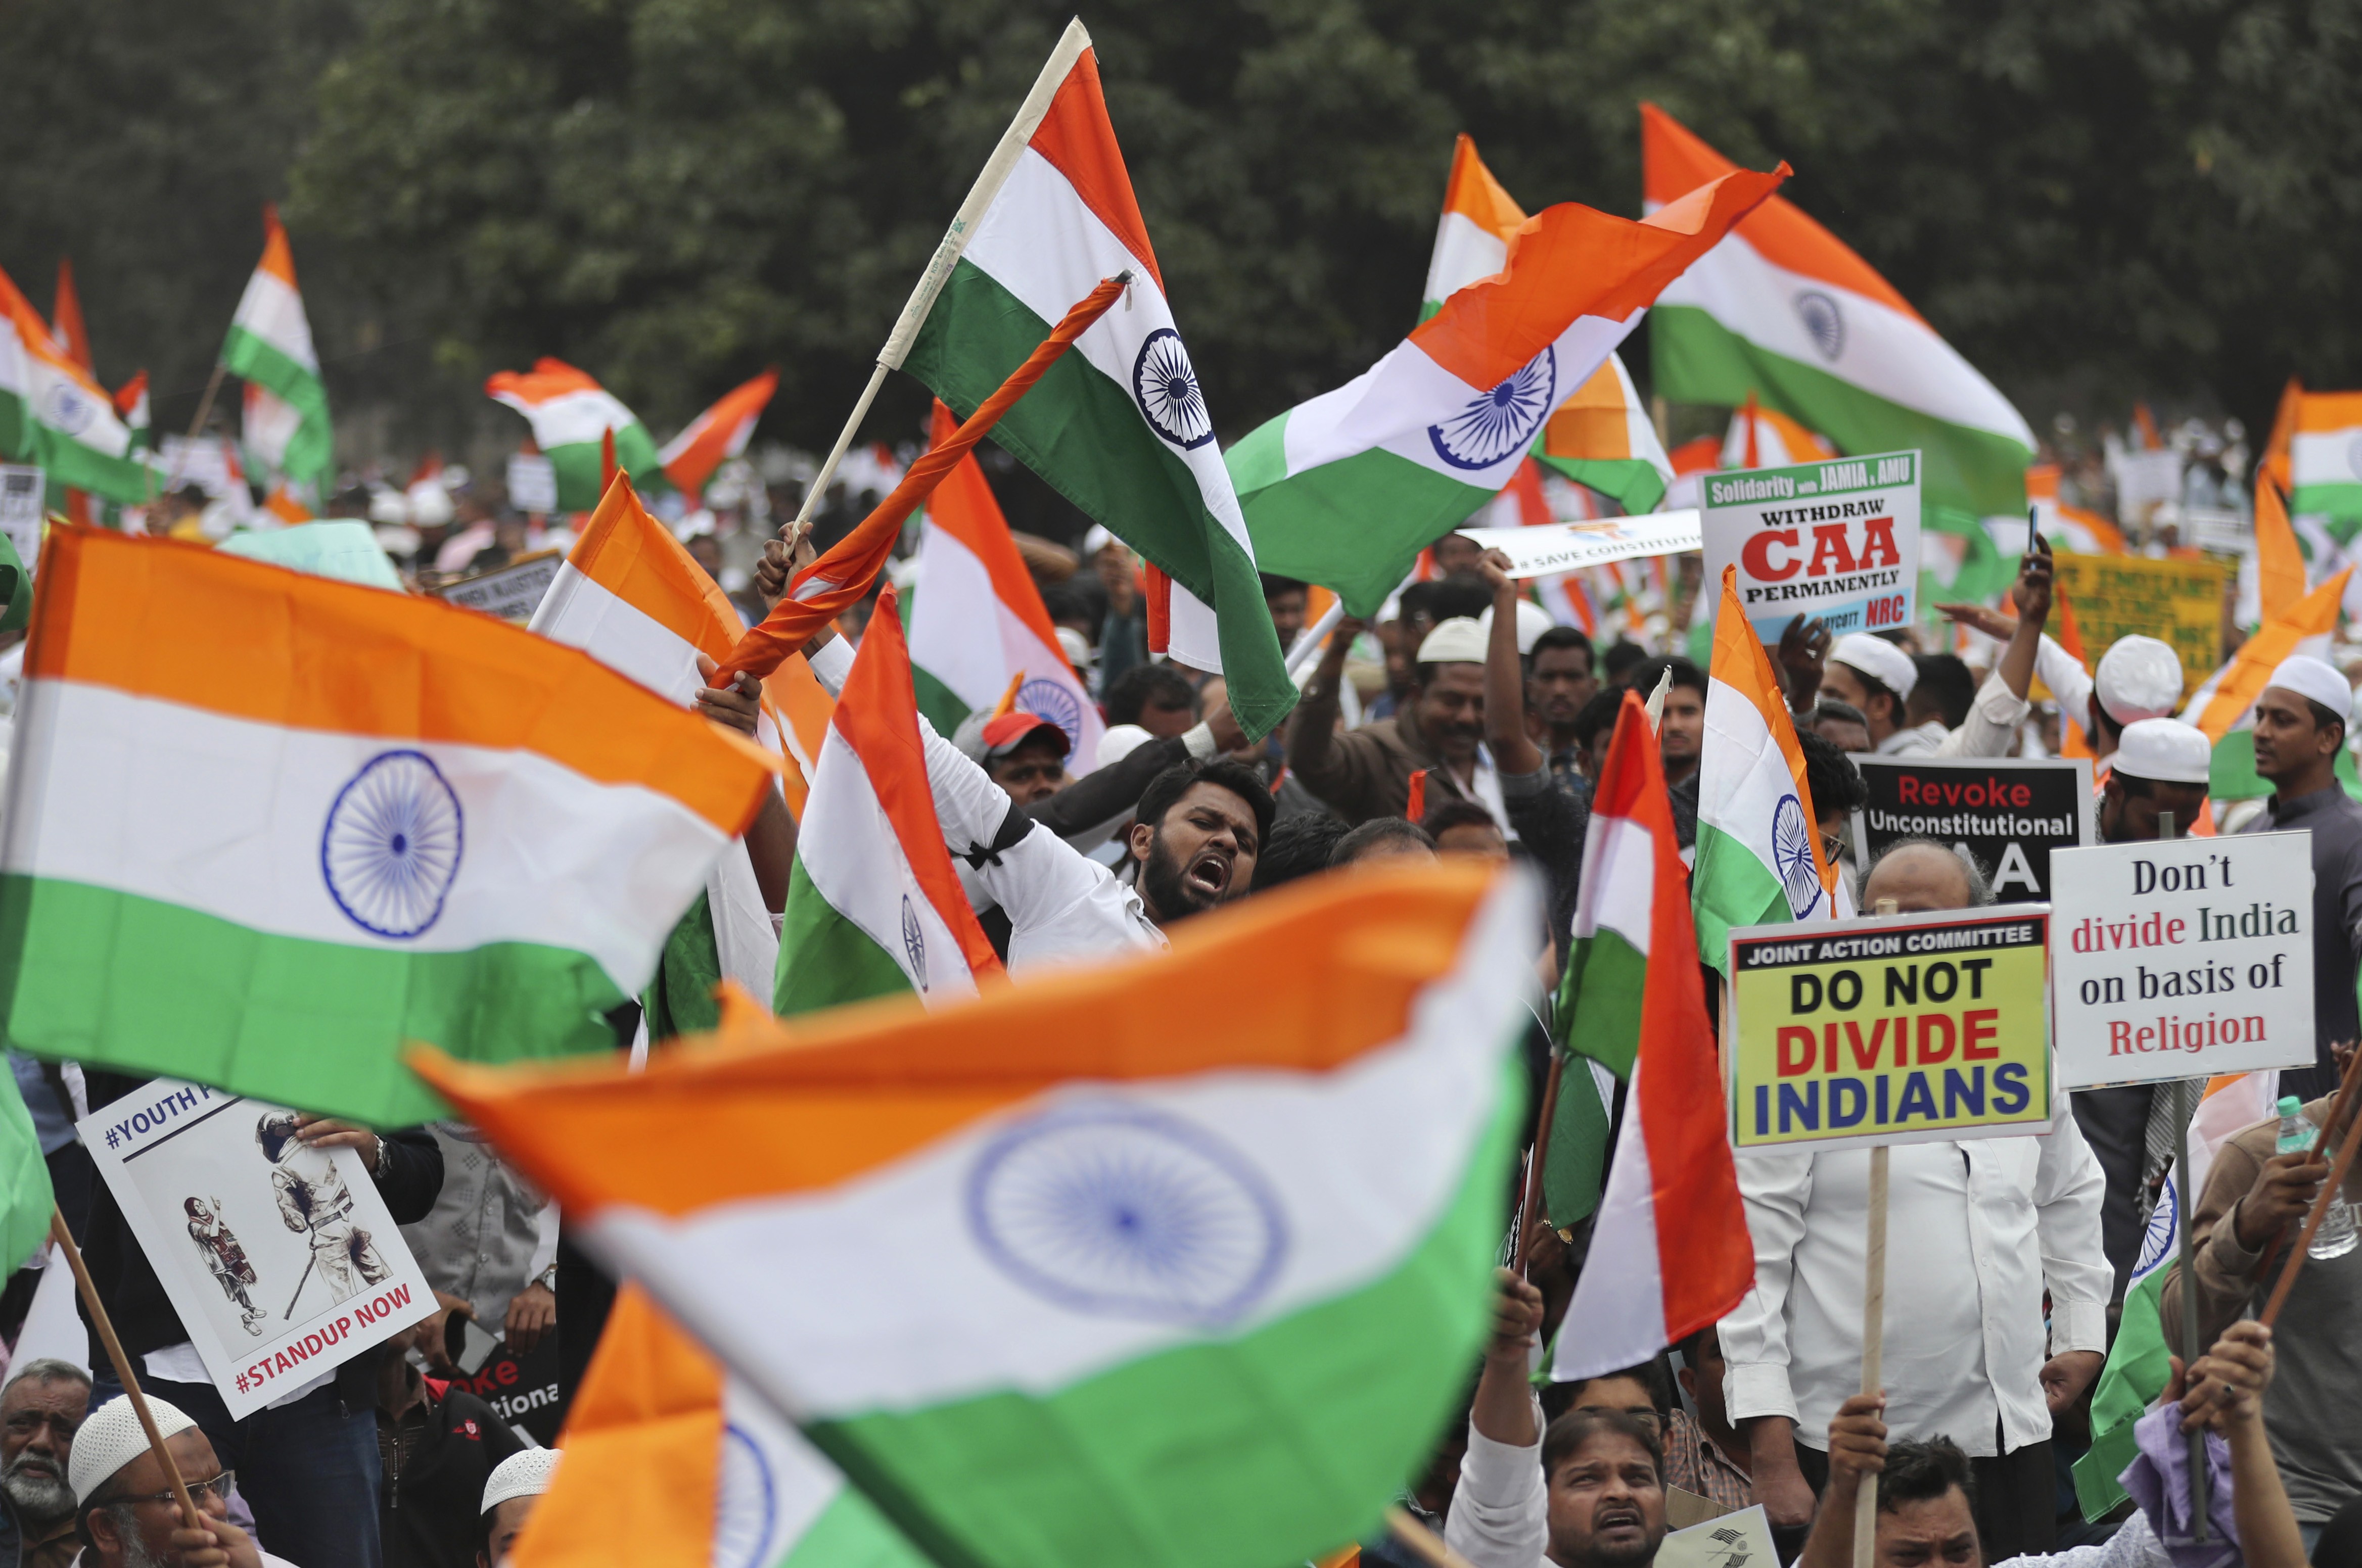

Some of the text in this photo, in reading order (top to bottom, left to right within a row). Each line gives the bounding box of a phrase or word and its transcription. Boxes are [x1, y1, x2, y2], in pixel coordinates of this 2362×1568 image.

[1711, 475, 1795, 504] Solidarity
[1796, 480, 1818, 495] with
[1820, 462, 1868, 492] JAMIA
[1877, 456, 1910, 485] AMU
[1761, 498, 1884, 527] WITHDRAW
[1535, 550, 1582, 569] SAVE
[1741, 516, 1900, 582] CAA
[1745, 569, 1899, 603] PERMANENTLY
[1820, 594, 1905, 632] OYCOTT NRC
[1898, 775, 2031, 807] Revoke
[1870, 808, 2072, 836] Unconstitutional
[2131, 854, 2234, 895] Don't
[1747, 925, 2033, 965] JOINT ACTION COMMITTEE
[2071, 902, 2300, 953] divide India
[1791, 958, 1993, 1015] DO NOT
[2079, 954, 2287, 1006] on basis of
[1777, 1009, 2000, 1078] DIVIDE
[2107, 1012, 2267, 1056] Religion
[106, 1087, 198, 1150] #YOUTH
[1755, 1063, 2029, 1136] INDIANS
[236, 1283, 411, 1394] #STANDUP NOW
